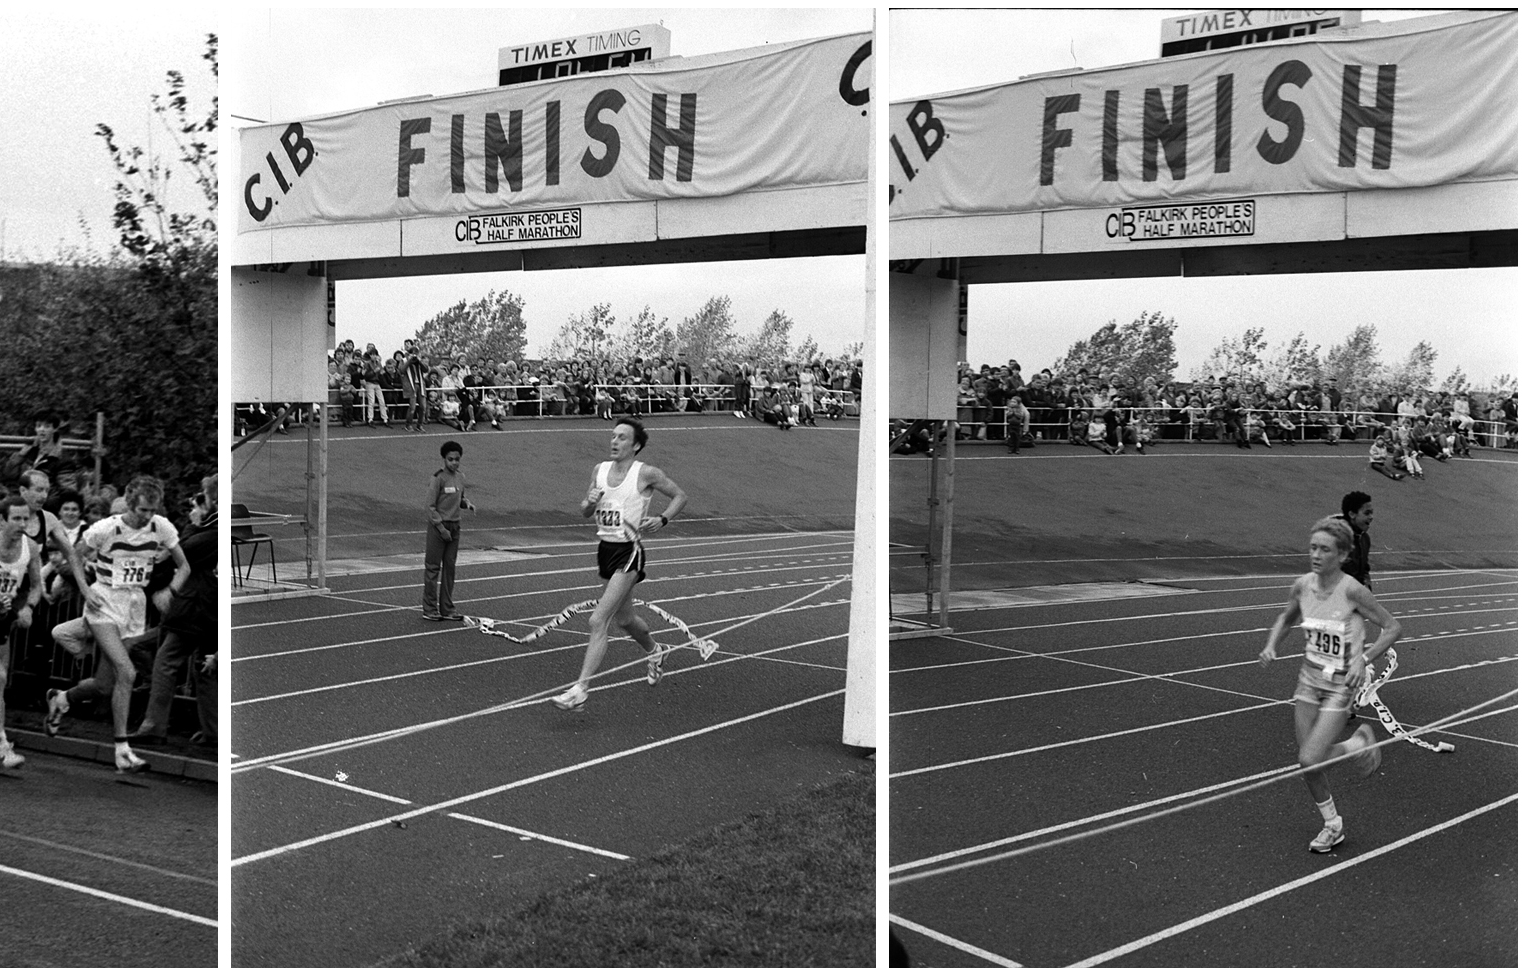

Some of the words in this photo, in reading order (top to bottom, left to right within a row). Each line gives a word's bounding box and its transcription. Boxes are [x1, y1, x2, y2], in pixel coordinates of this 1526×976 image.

[1176, 10, 1253, 37] TIMEX
[511, 39, 578, 64] TIMEX
[587, 29, 642, 52] TIMING
[1039, 59, 1397, 187] FINISH
[397, 88, 697, 198] FINISH
[889, 99, 950, 206] .I.B.
[244, 122, 319, 222] C.I.B.
[483, 215, 525, 229] FALKIRK
[528, 210, 579, 225] PEOPLE'S
[1105, 212, 1136, 238] CIB
[1138, 208, 1188, 223] FALKIRK
[1192, 203, 1253, 220] PEOPLE'S
[455, 219, 482, 242] CIB
[487, 228, 514, 241] HALF
[518, 225, 579, 239] MARATHON
[1143, 223, 1175, 237] HALF
[1180, 220, 1252, 237] MARATHON
